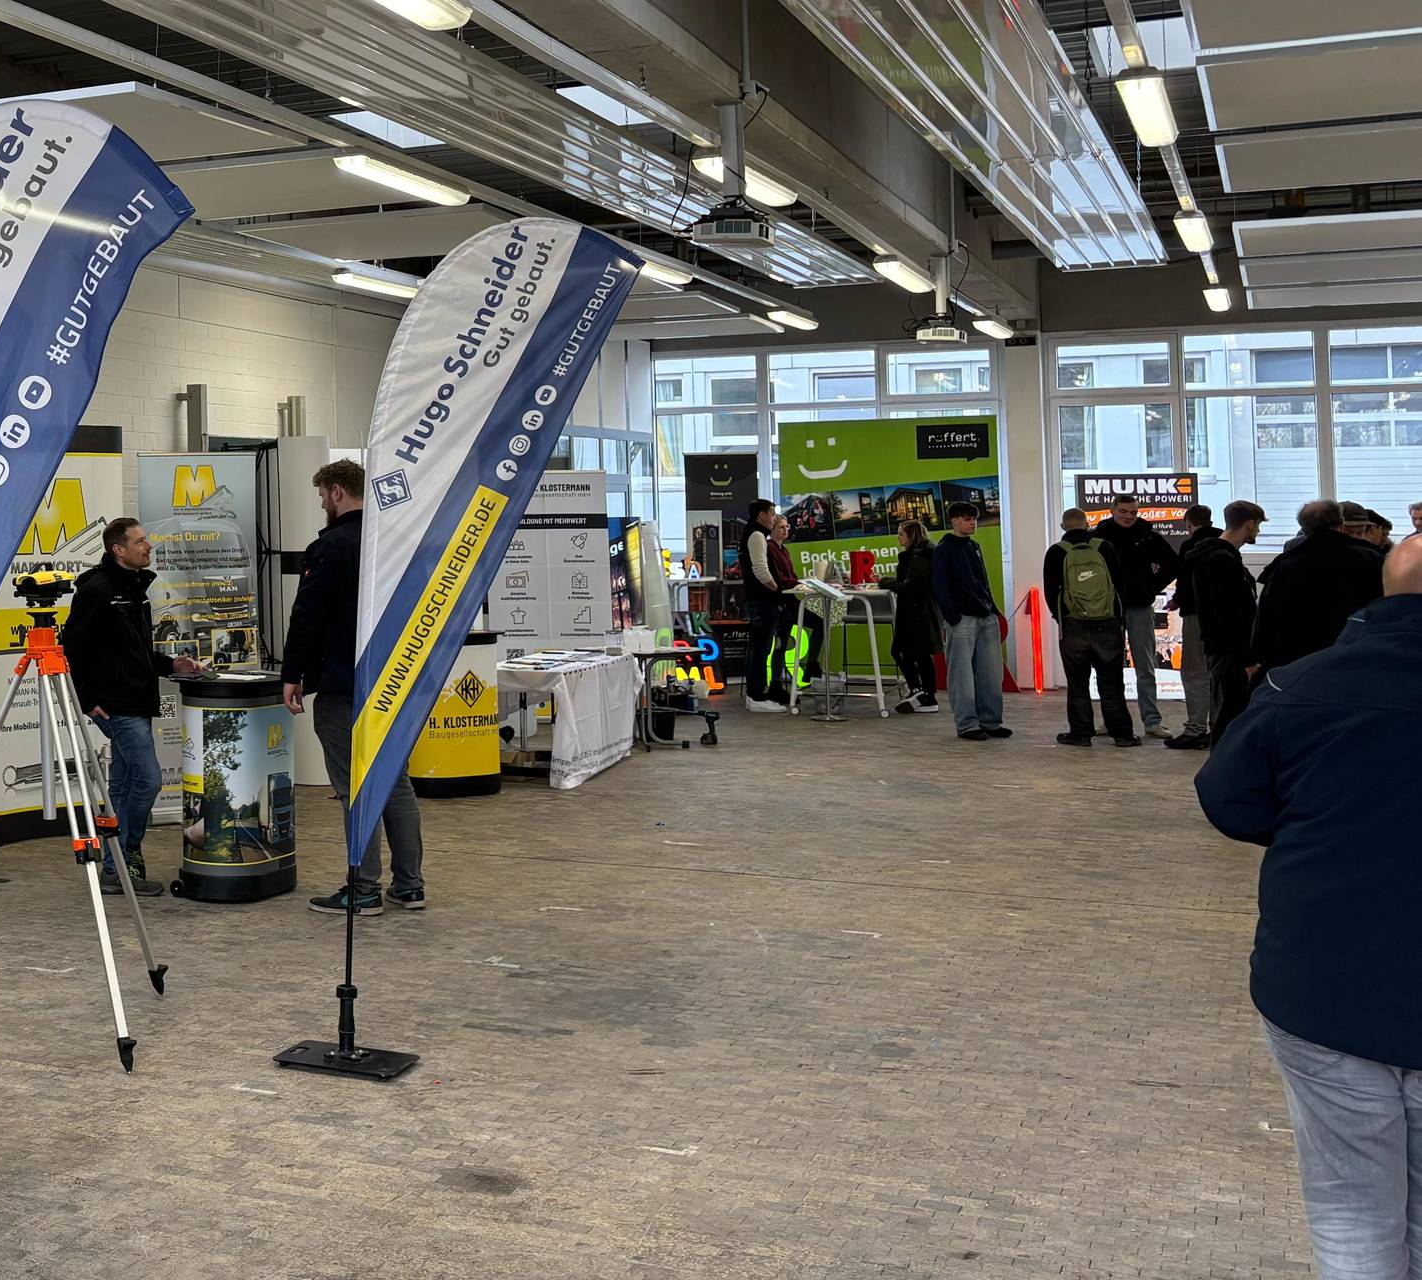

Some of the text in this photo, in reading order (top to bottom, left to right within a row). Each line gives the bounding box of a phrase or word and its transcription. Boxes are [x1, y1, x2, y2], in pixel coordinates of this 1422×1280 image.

[45, 188, 156, 366] #GUTGEBAUT
[483, 238, 556, 368] Gut gebaut.
[552, 262, 623, 377] #GUTGEBAUT
[395, 225, 529, 465] Hugo Schneider
[540, 484, 590, 492] KLOSTERMANN
[1085, 479, 1178, 494] MUNK
[1155, 495, 1192, 503] POWER!
[185, 532, 197, 541] Du
[200, 532, 220, 541] mit?
[800, 549, 838, 564] Bock
[374, 497, 497, 713] WWW.HUGOSCHNEIDER.DE
[429, 717, 440, 728] H.
